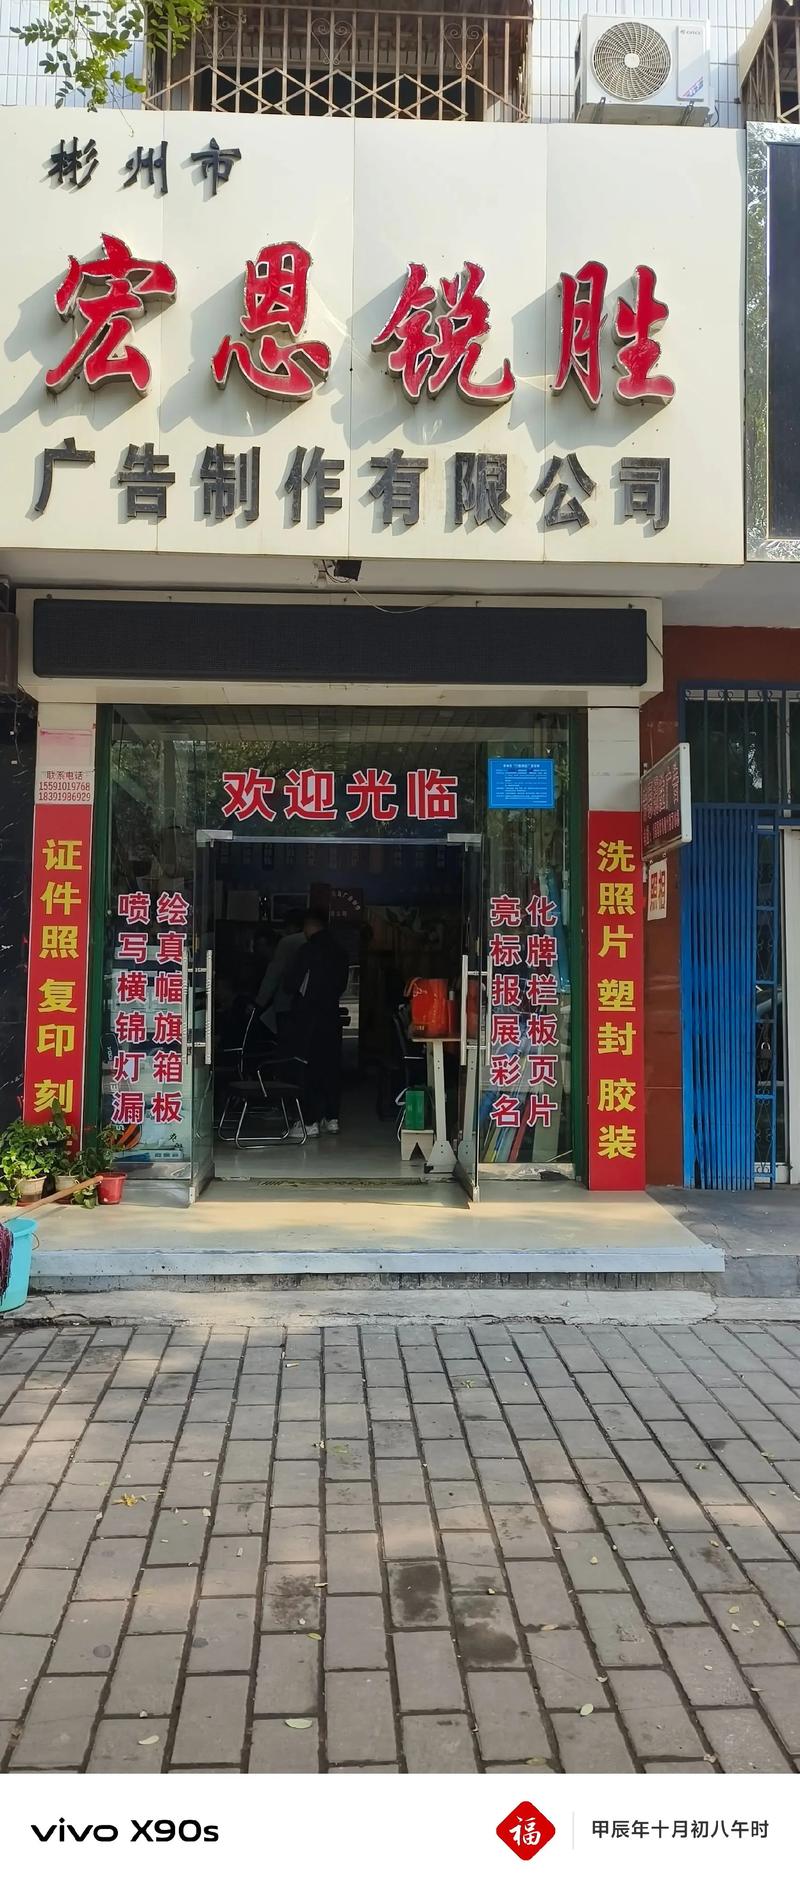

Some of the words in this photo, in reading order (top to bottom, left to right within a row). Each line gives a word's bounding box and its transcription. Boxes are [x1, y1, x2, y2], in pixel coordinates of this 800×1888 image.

[48, 137, 242, 196] 彬州市
[45, 232, 678, 411] 宏恩锐胜
[32, 437, 672, 532] 广告制作有限公司
[221, 768, 459, 822] 欢迎光临
